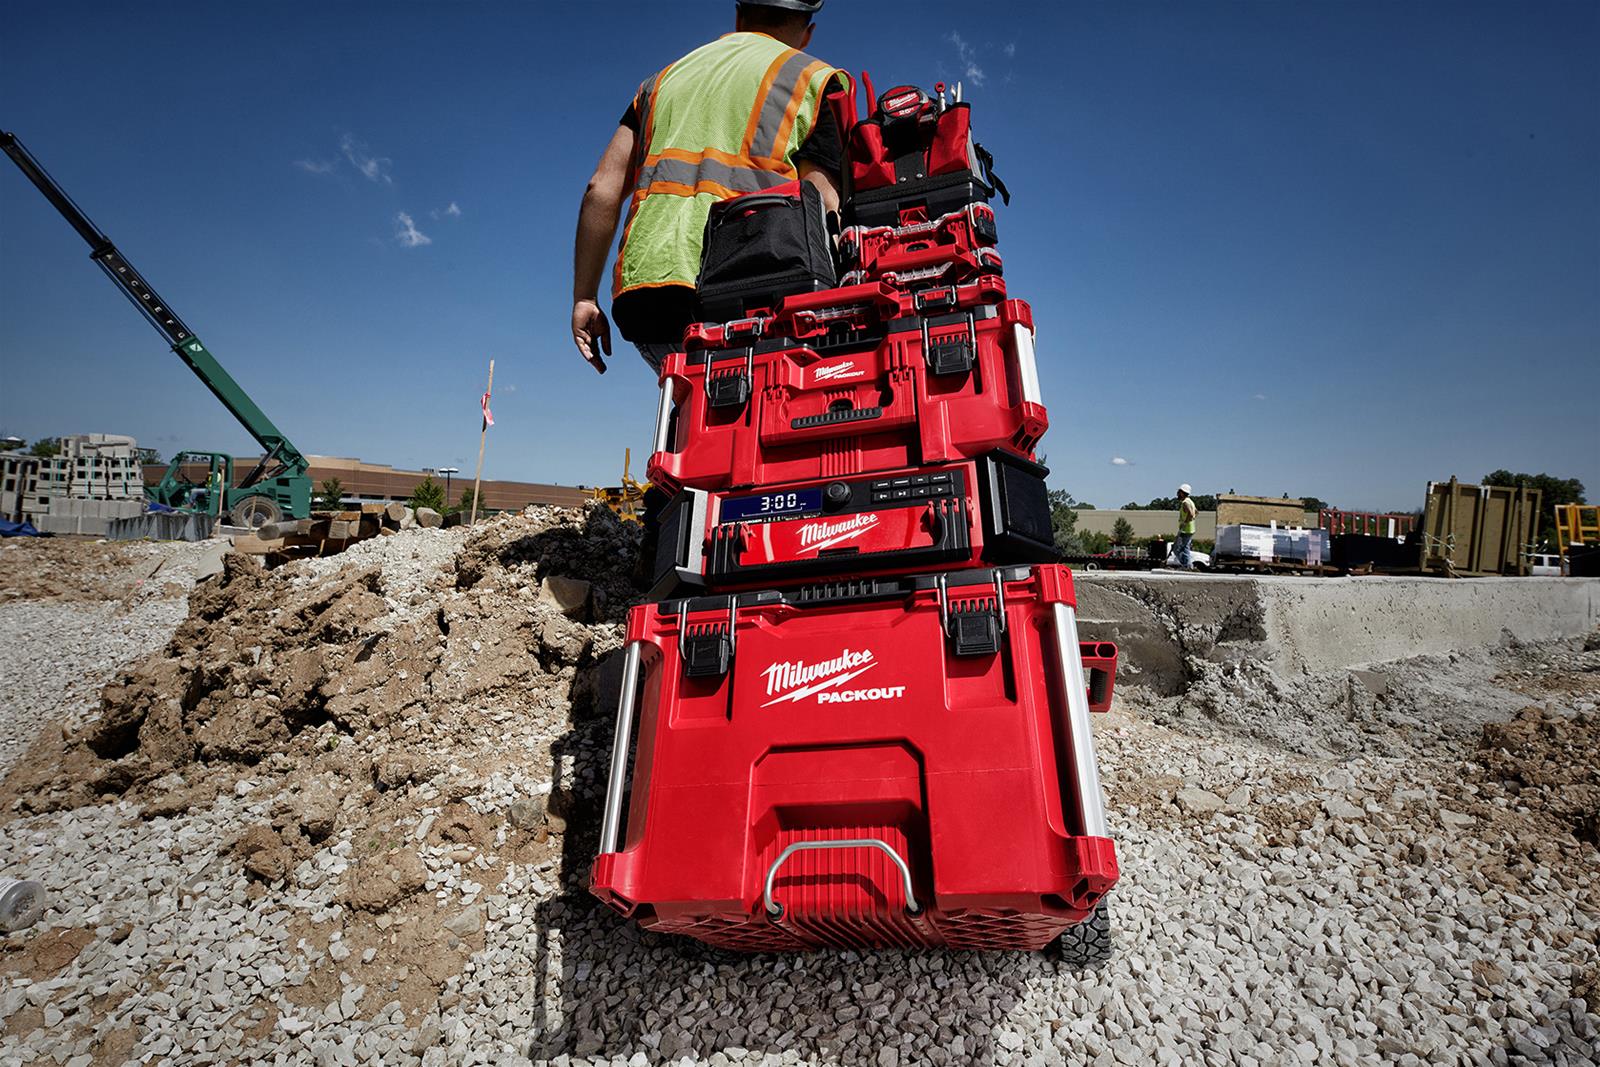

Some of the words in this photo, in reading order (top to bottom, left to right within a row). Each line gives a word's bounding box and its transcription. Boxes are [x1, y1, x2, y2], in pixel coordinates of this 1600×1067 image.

[813, 361, 854, 379] Milwaukee
[760, 493, 797, 511] 3:00
[795, 513, 878, 546] Milwaukee
[760, 648, 874, 696] Milwaukee
[817, 686, 906, 705] PACKOUT
